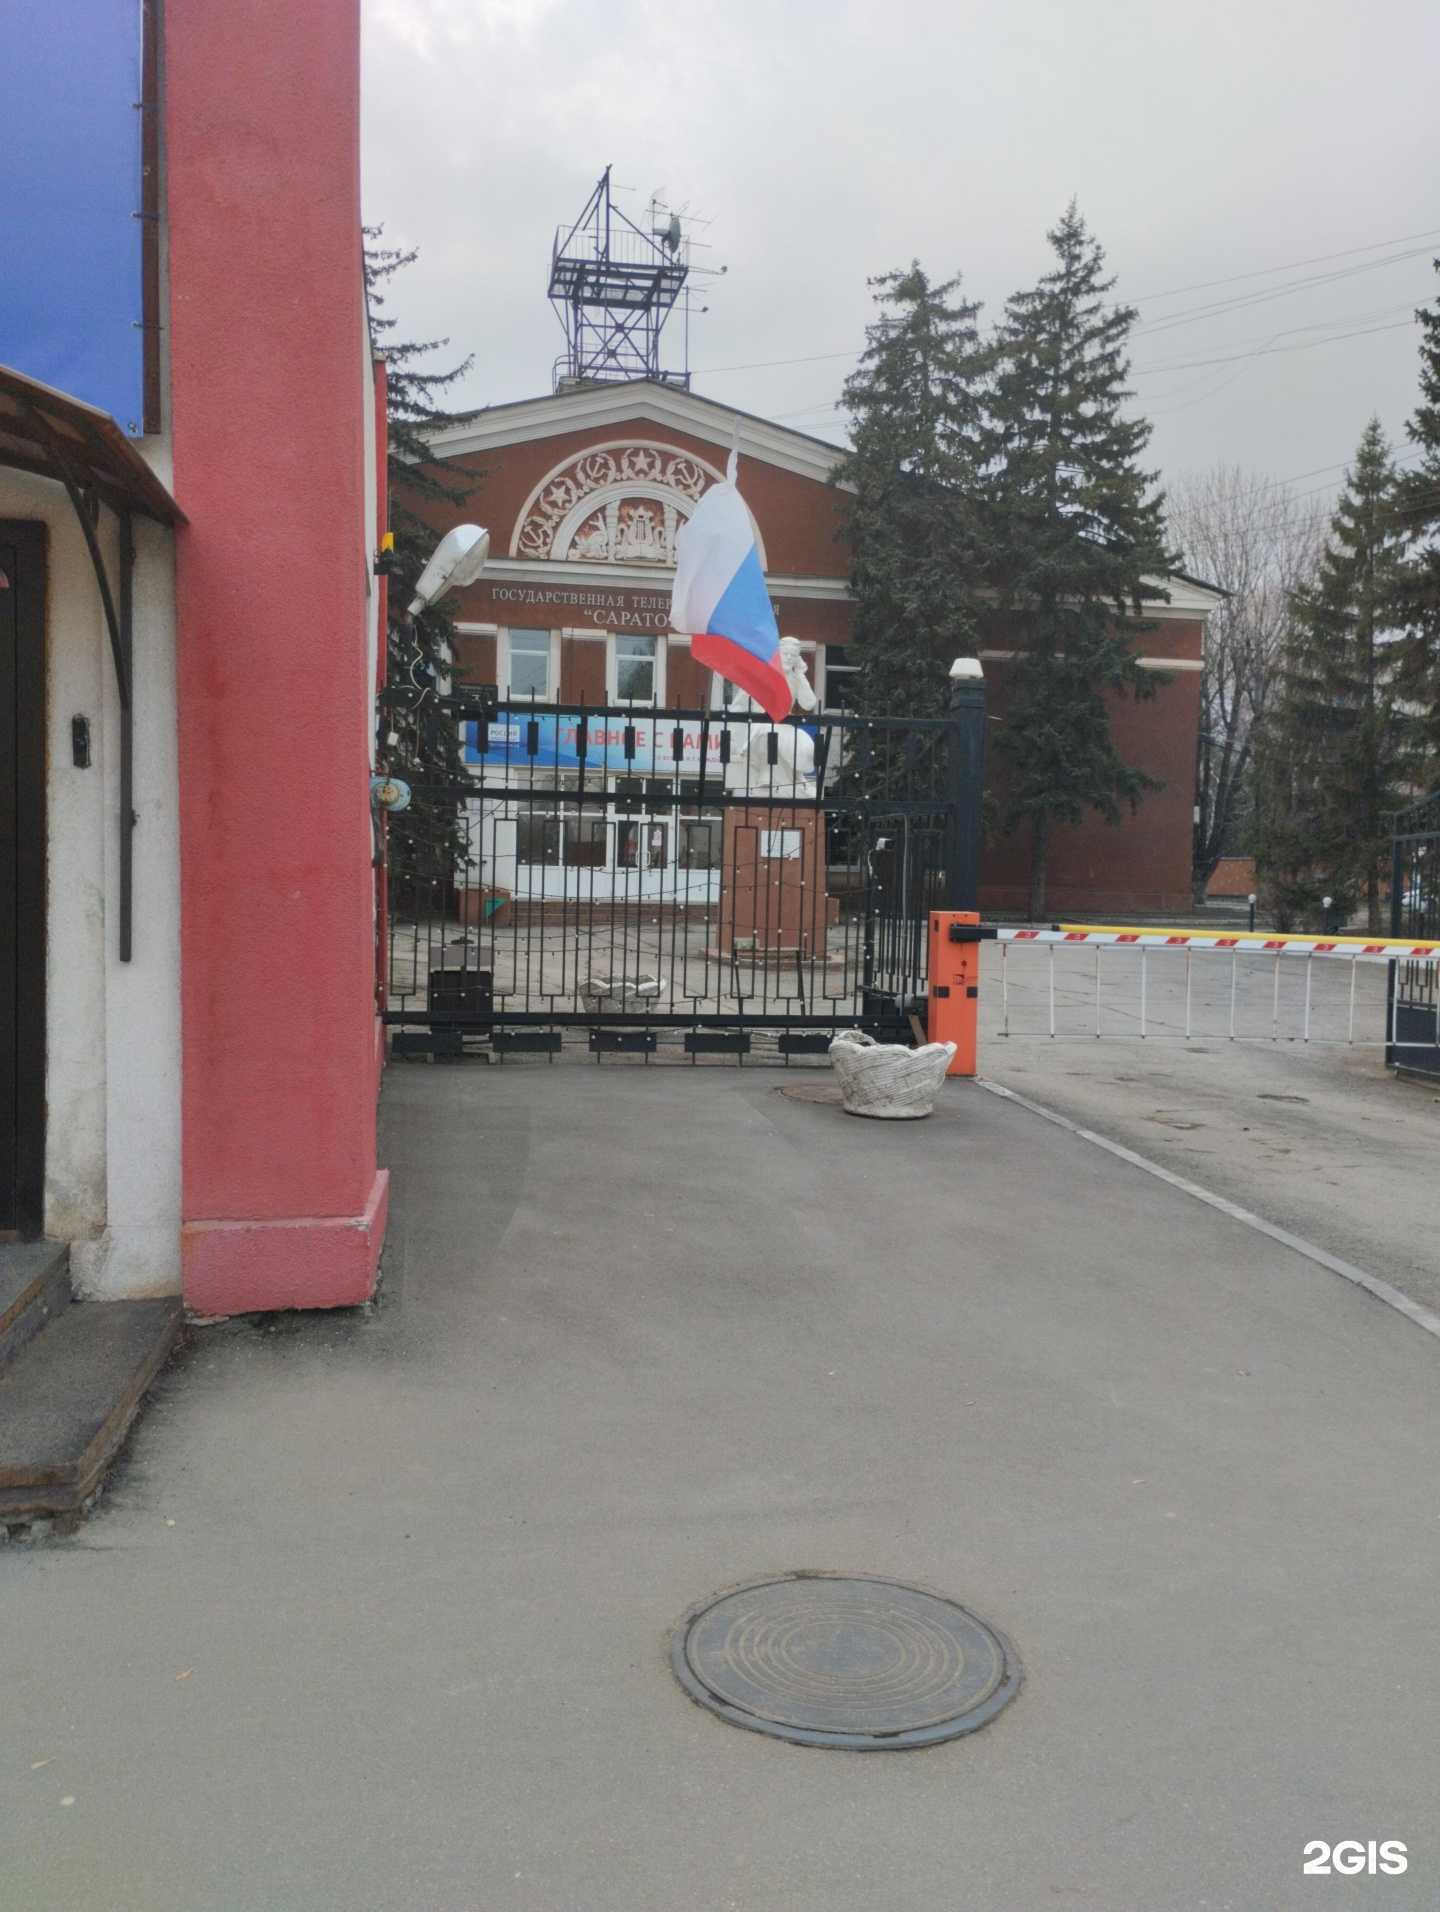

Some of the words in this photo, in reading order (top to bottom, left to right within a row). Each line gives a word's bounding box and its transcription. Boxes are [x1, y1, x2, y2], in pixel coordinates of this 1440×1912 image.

[491, 588, 625, 607] ГОСУДАРСТВЕННАЯ
[584, 609, 669, 628] “САРАТО
[557, 727, 646, 748] ГЛВНЕ
